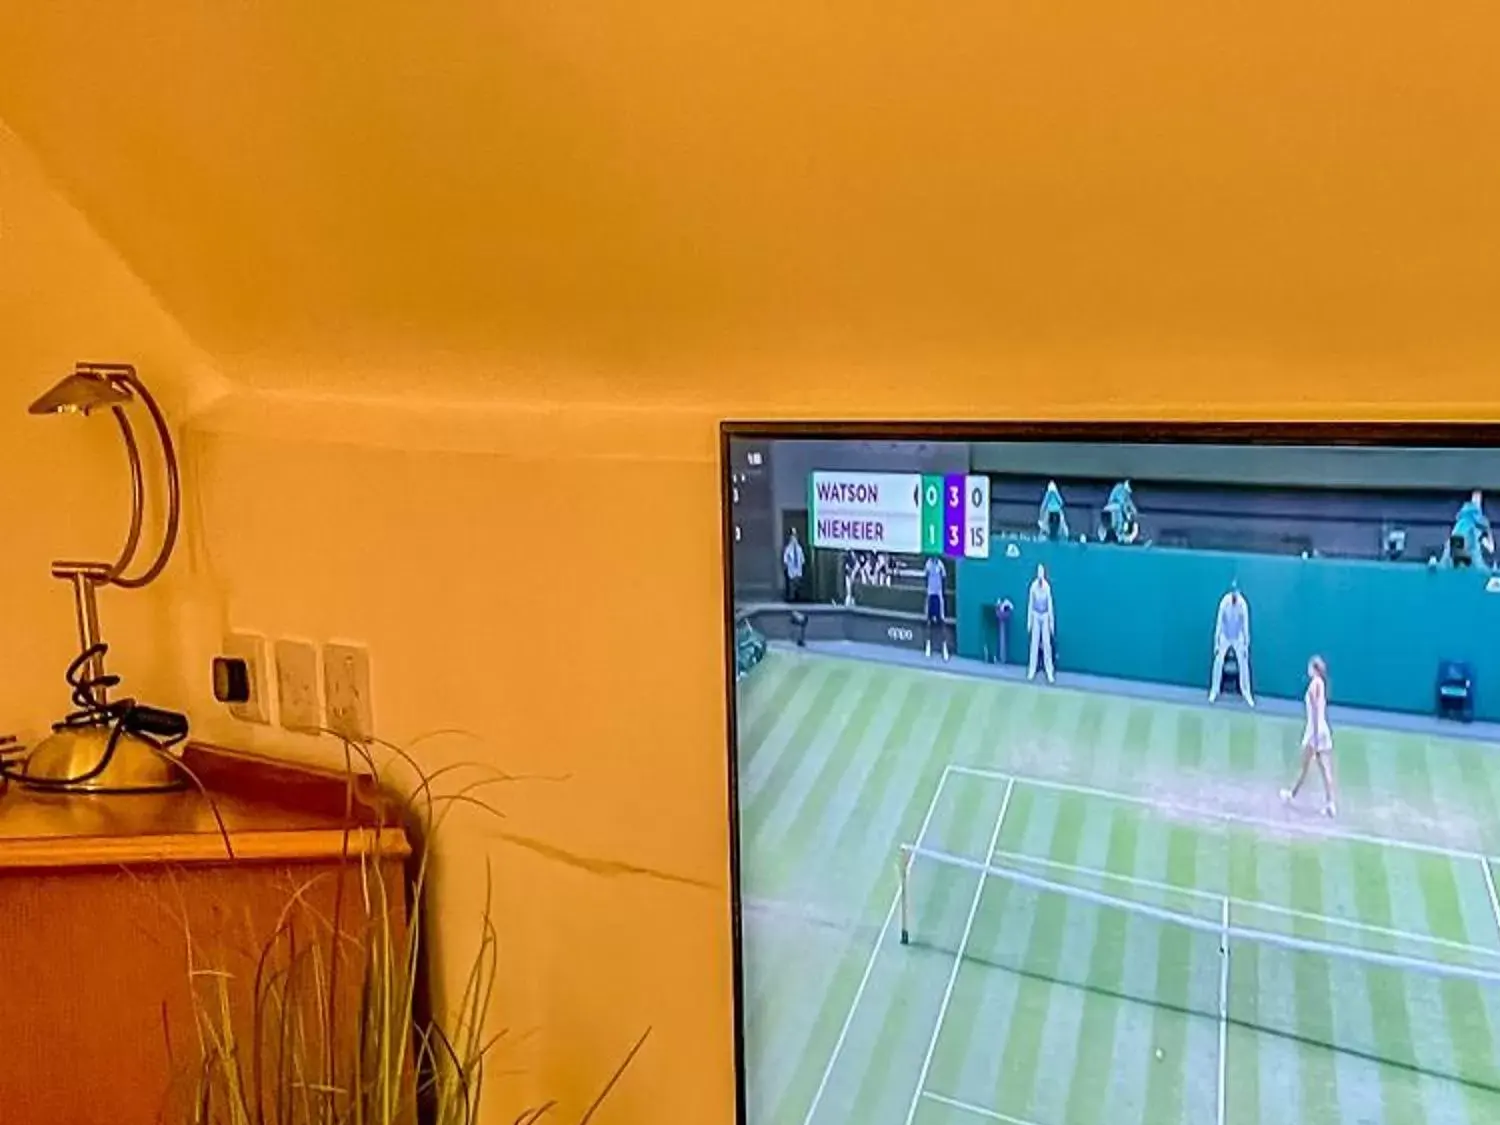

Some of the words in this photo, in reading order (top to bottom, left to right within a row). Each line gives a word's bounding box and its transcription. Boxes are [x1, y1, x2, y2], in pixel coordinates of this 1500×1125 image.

[816, 483, 878, 503] WATSON
[926, 484, 937, 507] 0
[949, 486, 959, 508] 3
[971, 487, 983, 508] 0
[817, 519, 884, 541] NIEMEIER
[929, 524, 936, 545] 1
[949, 525, 959, 547] 3
[971, 527, 984, 547] 15
